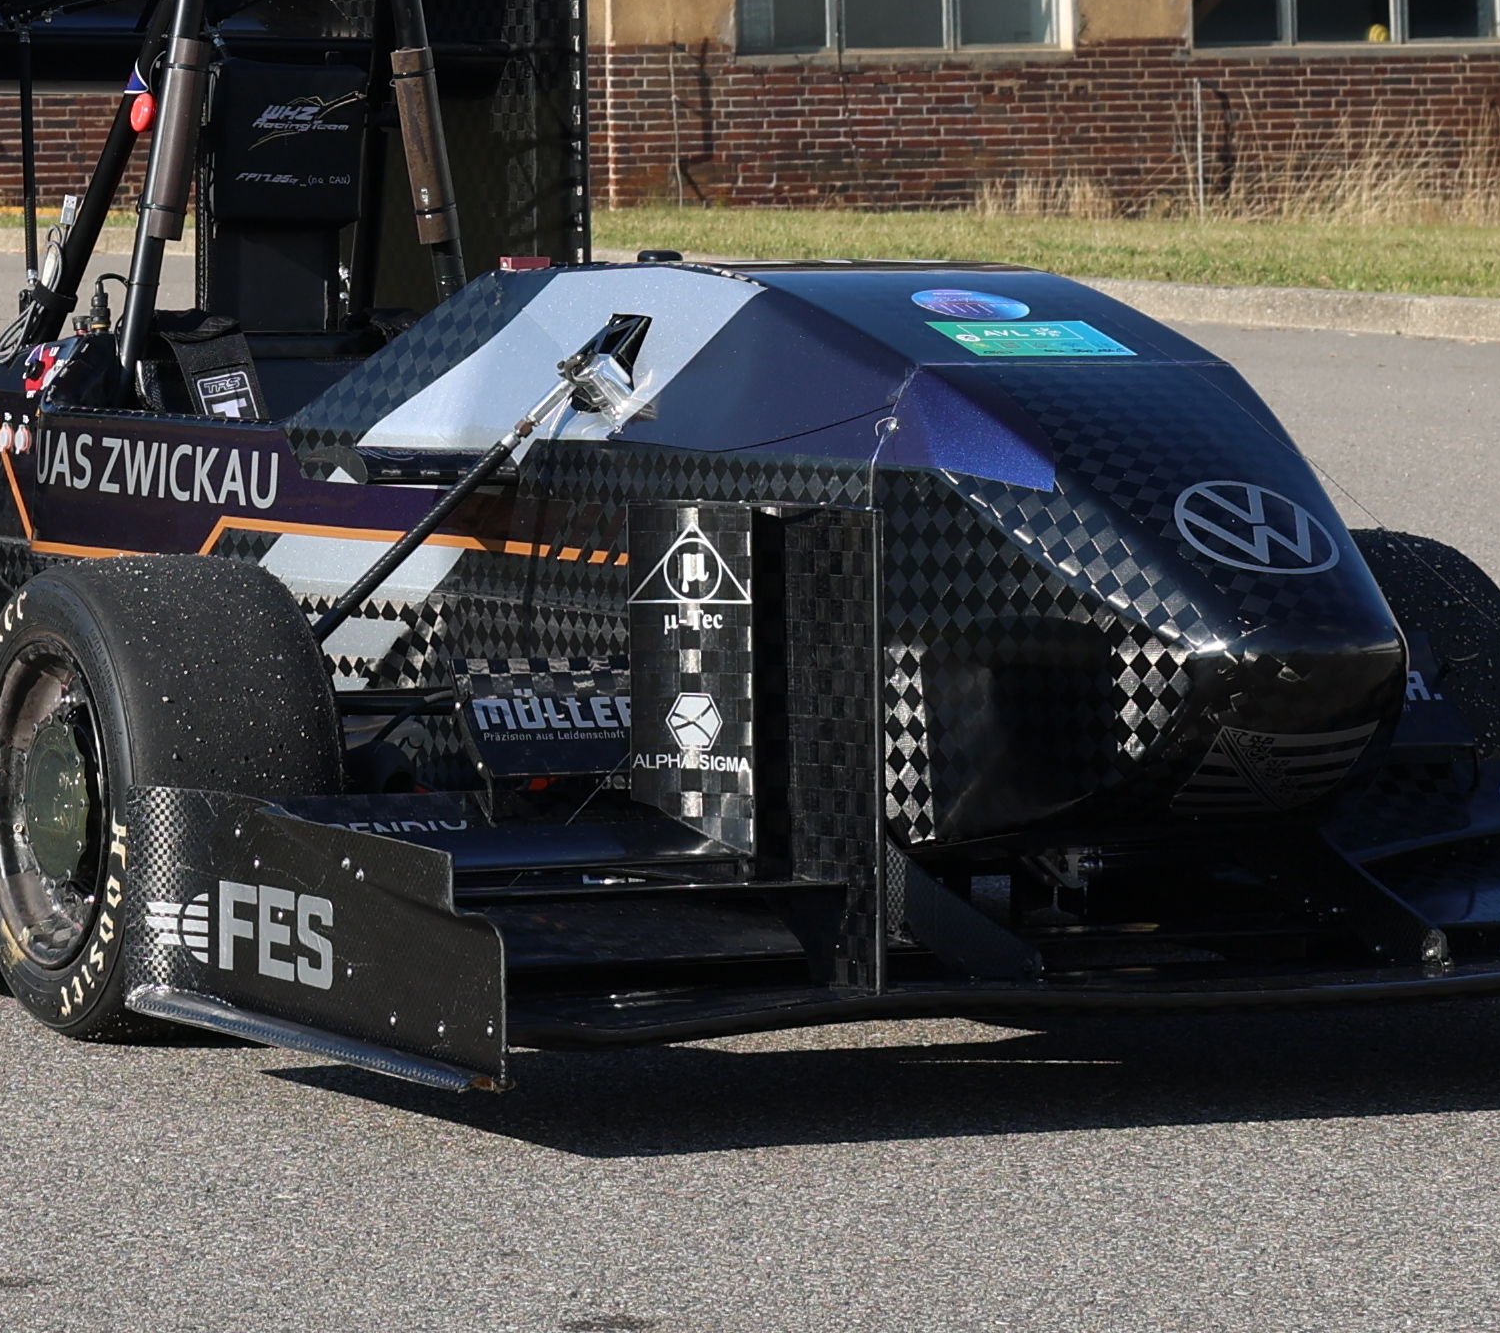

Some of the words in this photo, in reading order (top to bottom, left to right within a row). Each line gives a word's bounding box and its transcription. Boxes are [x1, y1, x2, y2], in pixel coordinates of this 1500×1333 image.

[329, 173, 351, 186] CAN)
[36, 428, 94, 490] UAS
[99, 437, 279, 510] ZWICKAU
[483, 730, 532, 742] Präzision
[535, 731, 554, 741] aus
[557, 729, 625, 741] Leidenschaft
[632, 753, 695, 770] ALPHA
[699, 754, 750, 773] SIGMA
[60, 807, 127, 1018] Hoosier
[218, 880, 334, 990] FES
